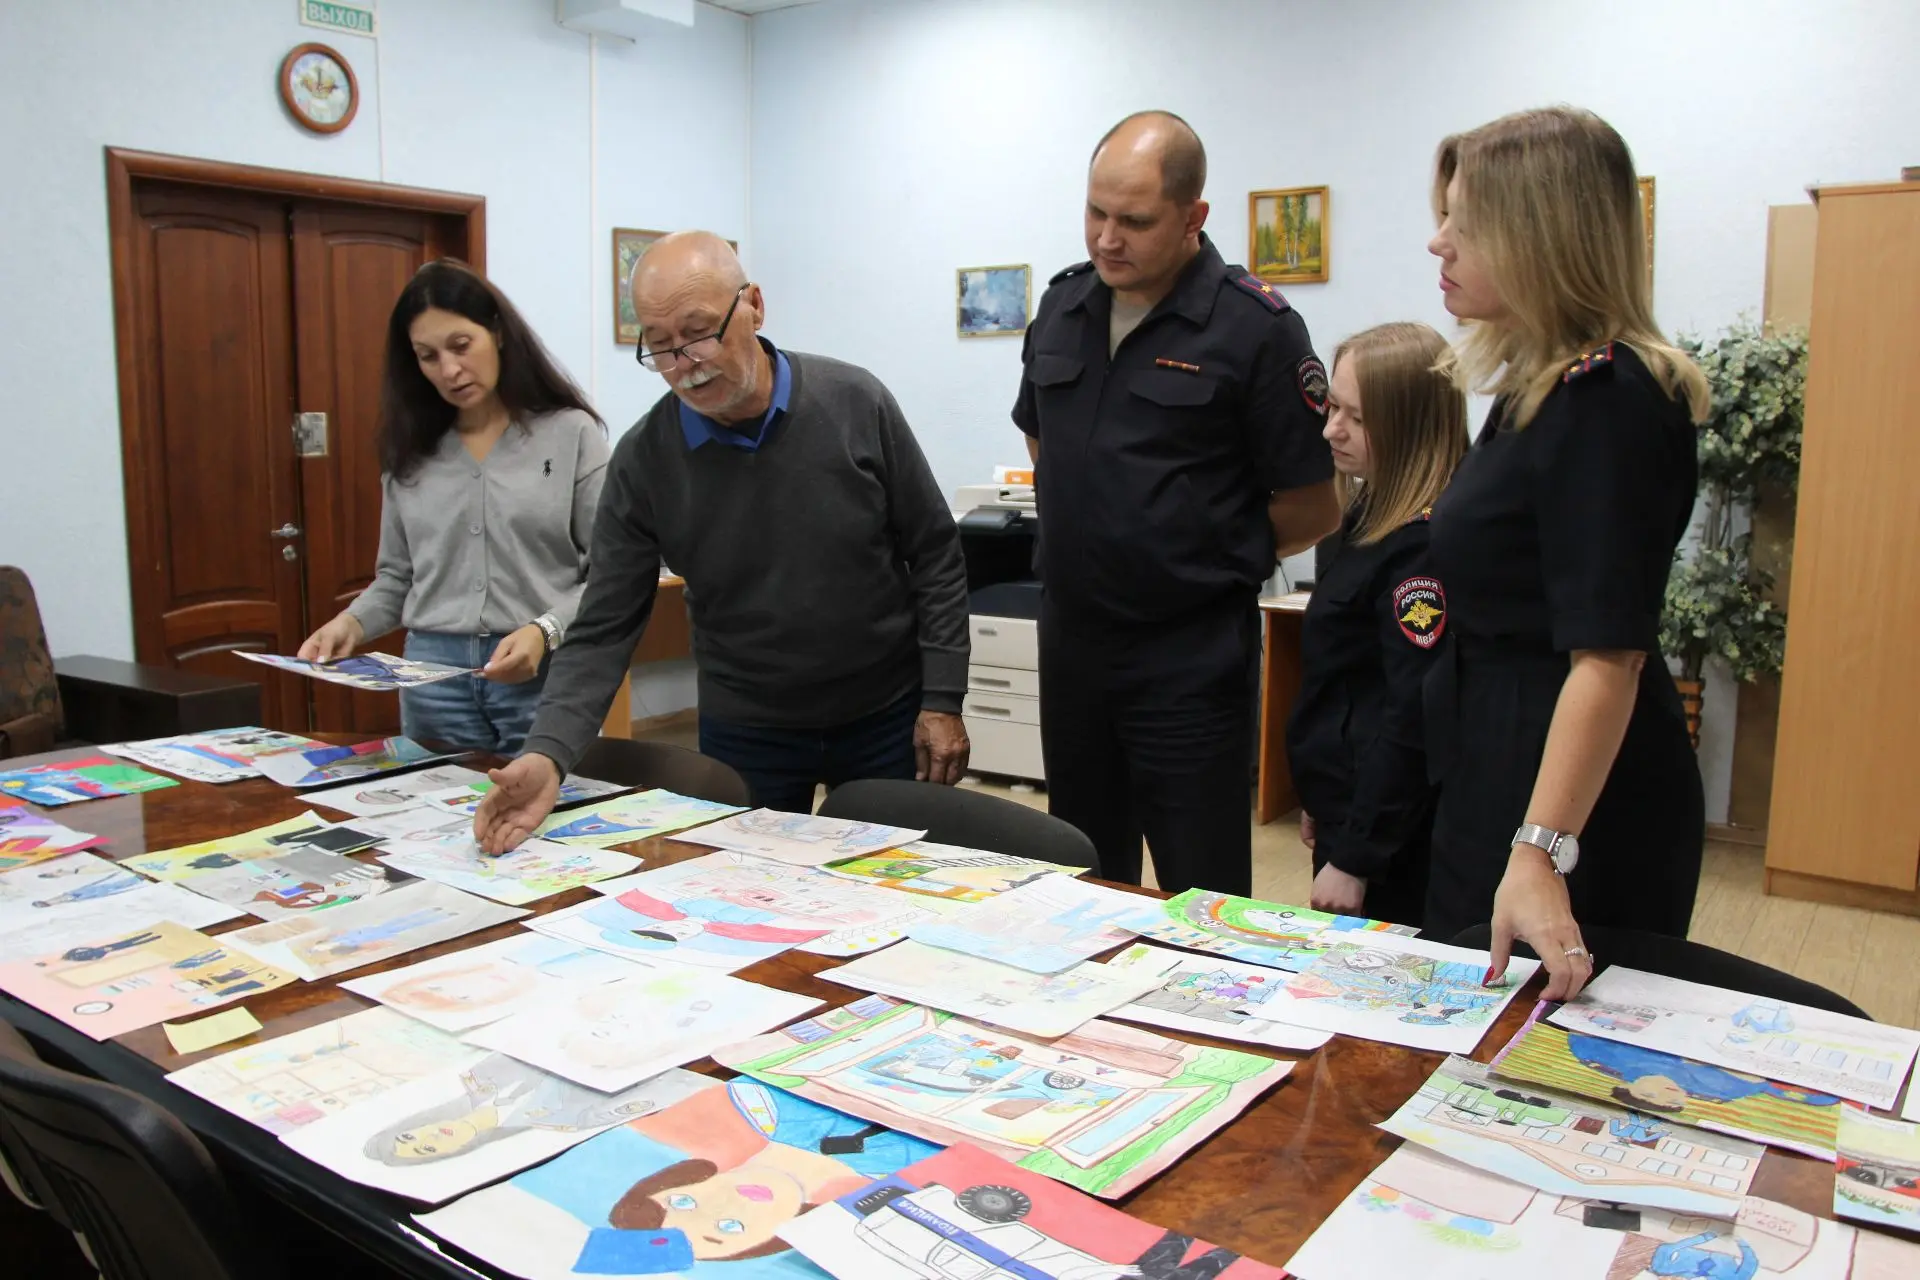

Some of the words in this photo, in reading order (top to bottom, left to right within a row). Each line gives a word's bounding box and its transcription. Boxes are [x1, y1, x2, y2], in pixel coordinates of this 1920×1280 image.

[308, 3, 369, 30] ВЫХОД
[1395, 580, 1438, 600] ПОЛИЦИЯ
[1401, 590, 1436, 608] РОССИЯ
[1415, 632, 1435, 645] МВД
